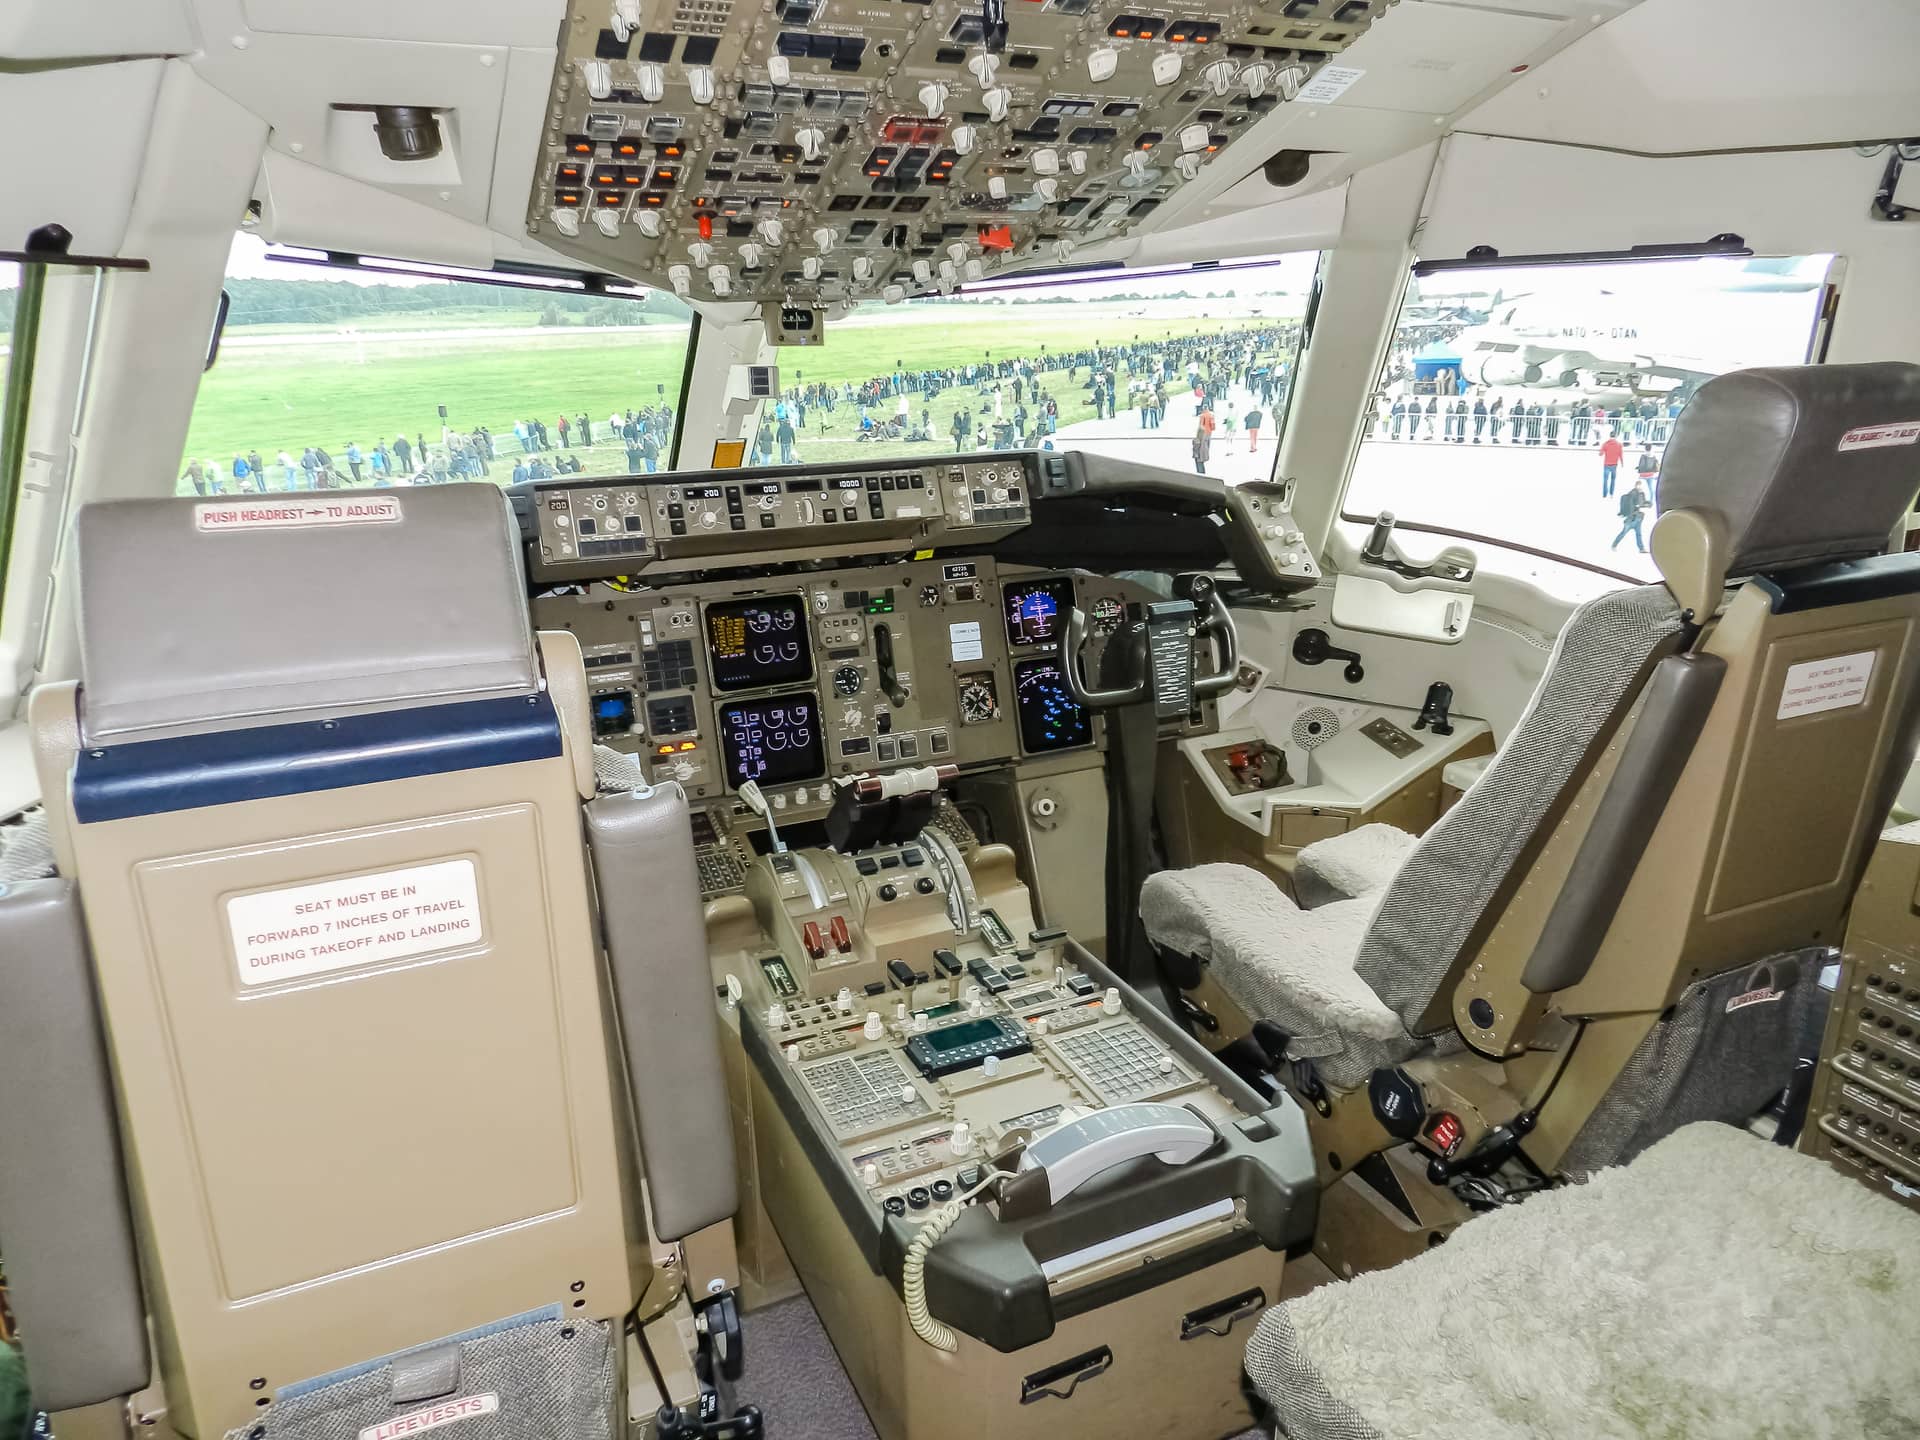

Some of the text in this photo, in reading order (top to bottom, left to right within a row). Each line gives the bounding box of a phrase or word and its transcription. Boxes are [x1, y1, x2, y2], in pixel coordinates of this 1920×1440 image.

[1562, 326, 1637, 339] NATO OTAN
[704, 489, 720, 498] 200
[203, 504, 393, 523] PUSH HEADREST TO ADJUST
[551, 501, 567, 510] 200
[294, 885, 417, 915] SEAT MUST BE IN
[247, 899, 465, 946] FORWARD 7 INCHES OF TRAVEL
[250, 919, 471, 968] DURING TAKEOFF AND LANDING
